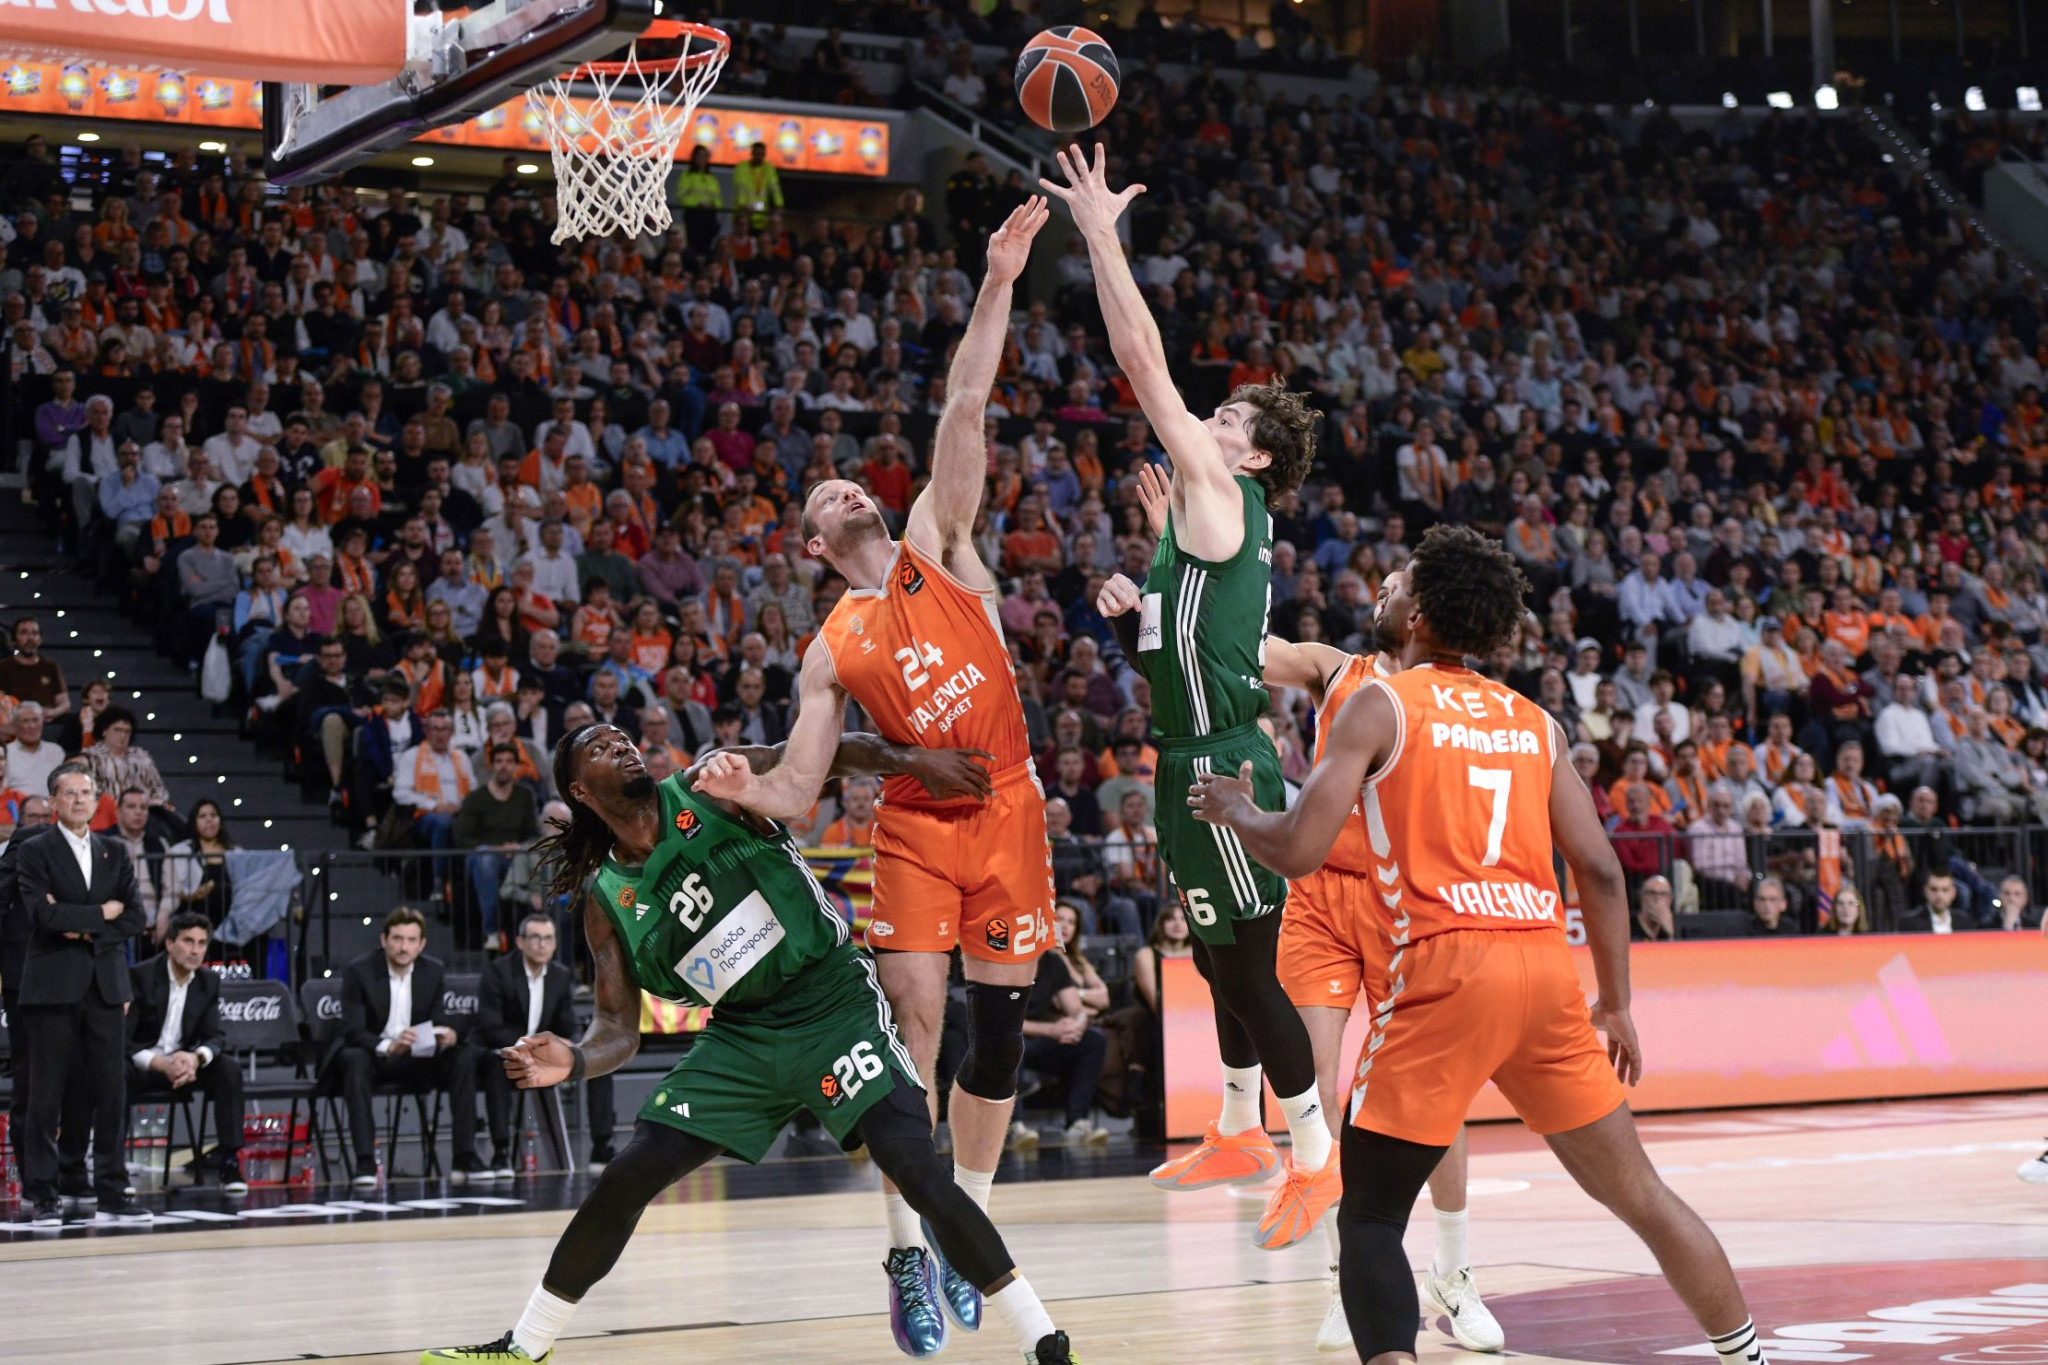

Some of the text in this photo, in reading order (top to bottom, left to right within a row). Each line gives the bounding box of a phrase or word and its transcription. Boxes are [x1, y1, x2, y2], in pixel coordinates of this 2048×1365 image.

[894, 635, 944, 692] 24
[907, 662, 987, 735] VALENCIA
[938, 696, 973, 734] BASKET
[1431, 684, 1515, 719] KEY
[1432, 723, 1539, 754] PAMESA
[1468, 765, 1512, 867] 7
[670, 873, 714, 933] 26
[1437, 880, 1558, 922] VALENCA
[709, 926, 747, 960] Ομάδα
[719, 918, 779, 973] Προσφοράς
[1013, 907, 1050, 955] 24
[217, 995, 281, 1021] oca-Cola
[833, 1041, 884, 1100] 26
